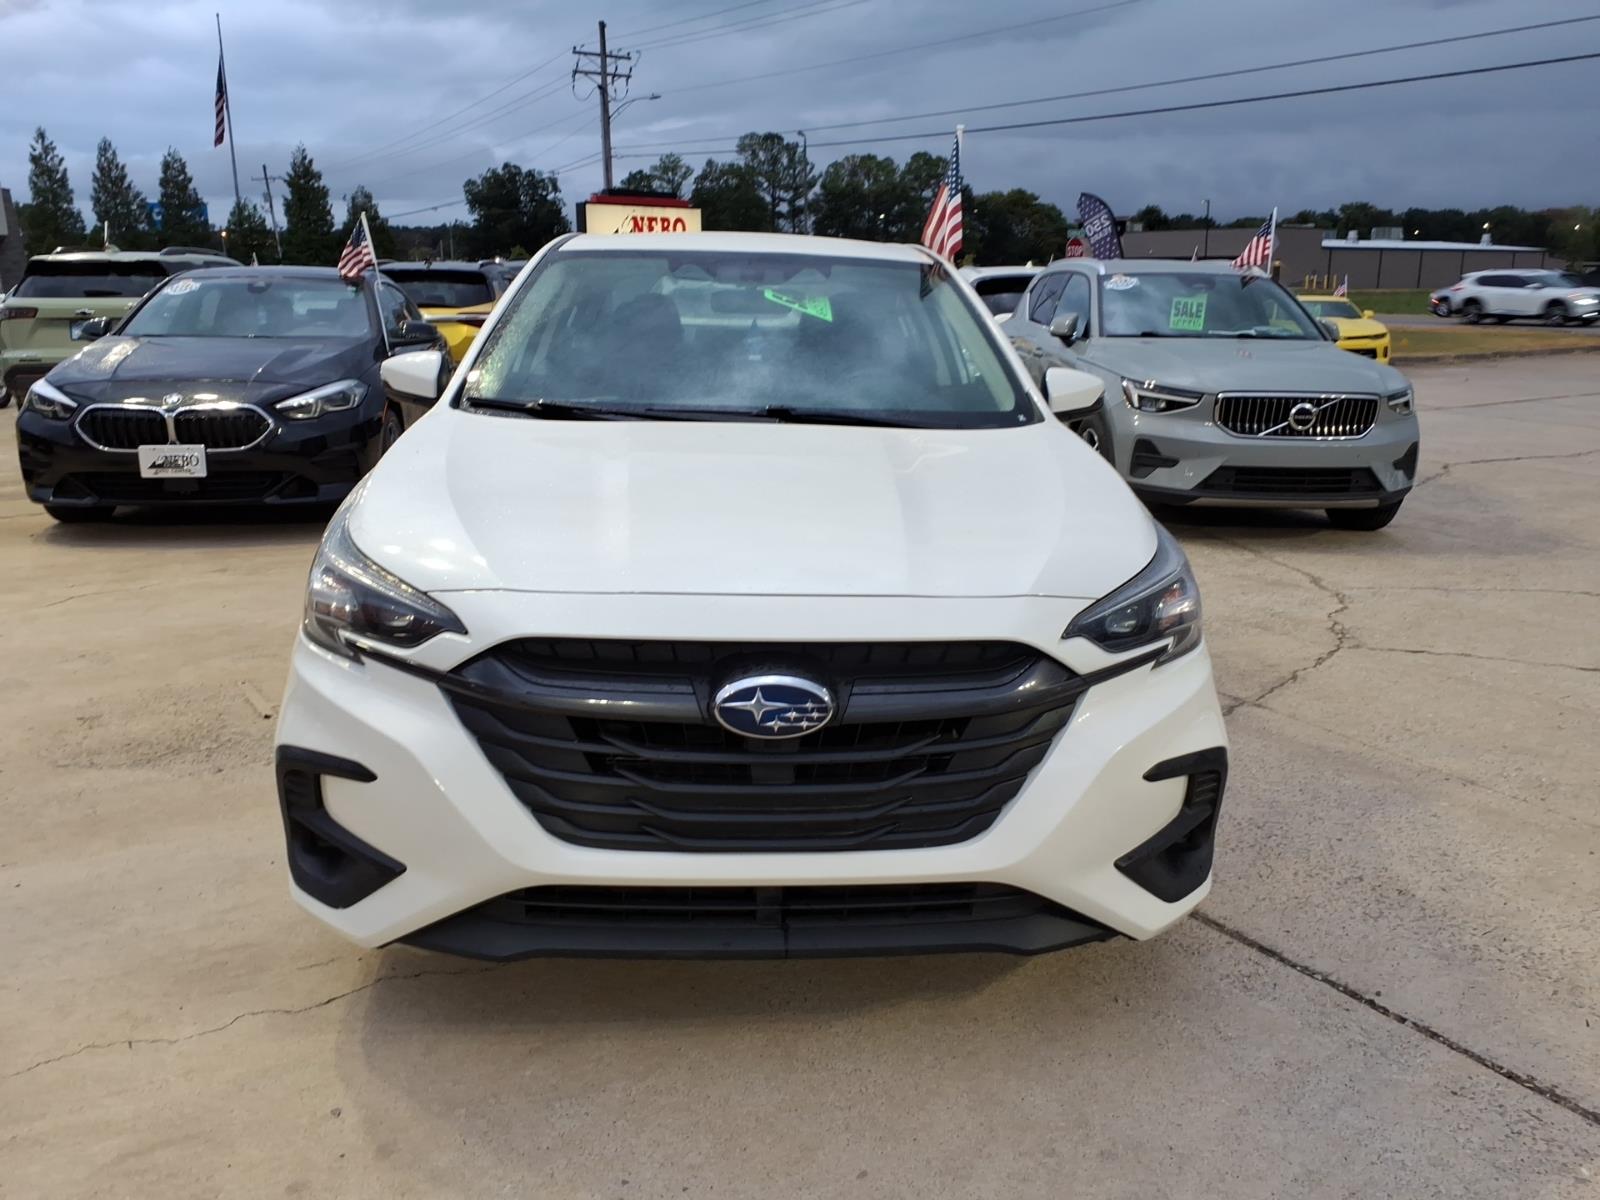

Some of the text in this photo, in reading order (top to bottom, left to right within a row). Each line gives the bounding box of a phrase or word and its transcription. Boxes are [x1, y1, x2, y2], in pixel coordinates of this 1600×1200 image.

[1067, 245, 1083, 257] STOP
[1173, 300, 1204, 318] SALE
[163, 454, 200, 468] NEBO
